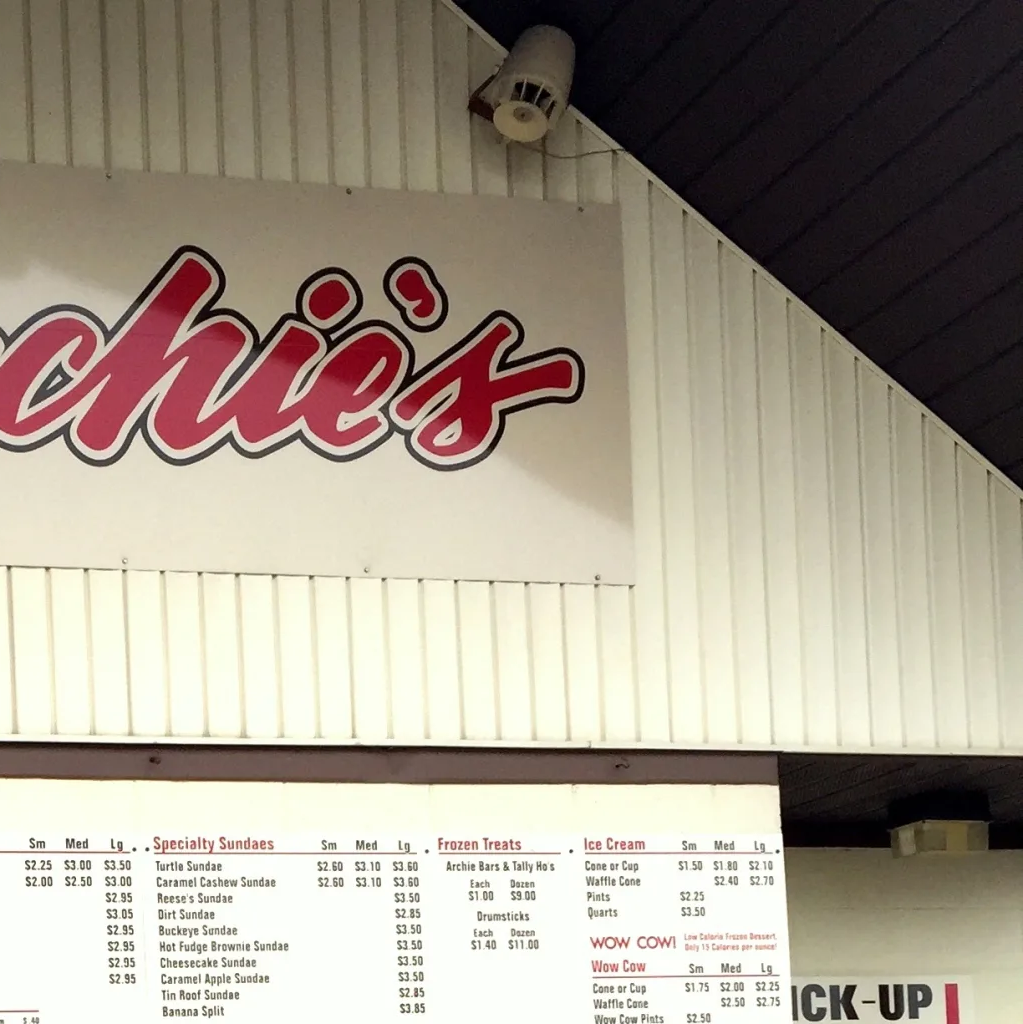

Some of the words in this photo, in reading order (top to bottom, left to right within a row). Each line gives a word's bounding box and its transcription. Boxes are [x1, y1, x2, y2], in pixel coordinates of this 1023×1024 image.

[29, 838, 45, 849] Sm
[66, 838, 88, 849] Med
[109, 839, 125, 853] Lg
[154, 837, 216, 854] Specialty
[219, 837, 274, 850] Sundaes
[322, 840, 337, 850] Sm
[356, 840, 377, 850] Med
[397, 840, 412, 854] Lg
[438, 838, 478, 850] Frozen
[483, 838, 521, 850] Treats
[584, 838, 602, 850] Ice
[607, 837, 645, 850] Cream
[682, 841, 696, 850] Sm
[714, 841, 734, 850] Med
[753, 841, 767, 853] Lg
[25, 860, 52, 870] $2.25
[64, 860, 91, 870] $3.00
[104, 860, 131, 870] $3.50
[587, 892, 610, 902] Pints
[680, 891, 704, 901] $2.25
[477, 911, 529, 921] Drumsticks
[107, 925, 134, 935] $2.95
[160, 941, 176, 952] Hot
[180, 941, 207, 954] Fudge
[211, 941, 250, 951] Brownie
[254, 941, 288, 951] Sundae
[397, 940, 422, 950] $3.50
[590, 937, 630, 949] WOW
[637, 936, 676, 949] COW!
[592, 960, 619, 972] Wow
[623, 960, 645, 972] Cow
[792, 983, 932, 1022] ICK-UP
[163, 1006, 198, 1017] Banana
[202, 1006, 224, 1018] Split
[400, 1003, 425, 1013] $3.85
